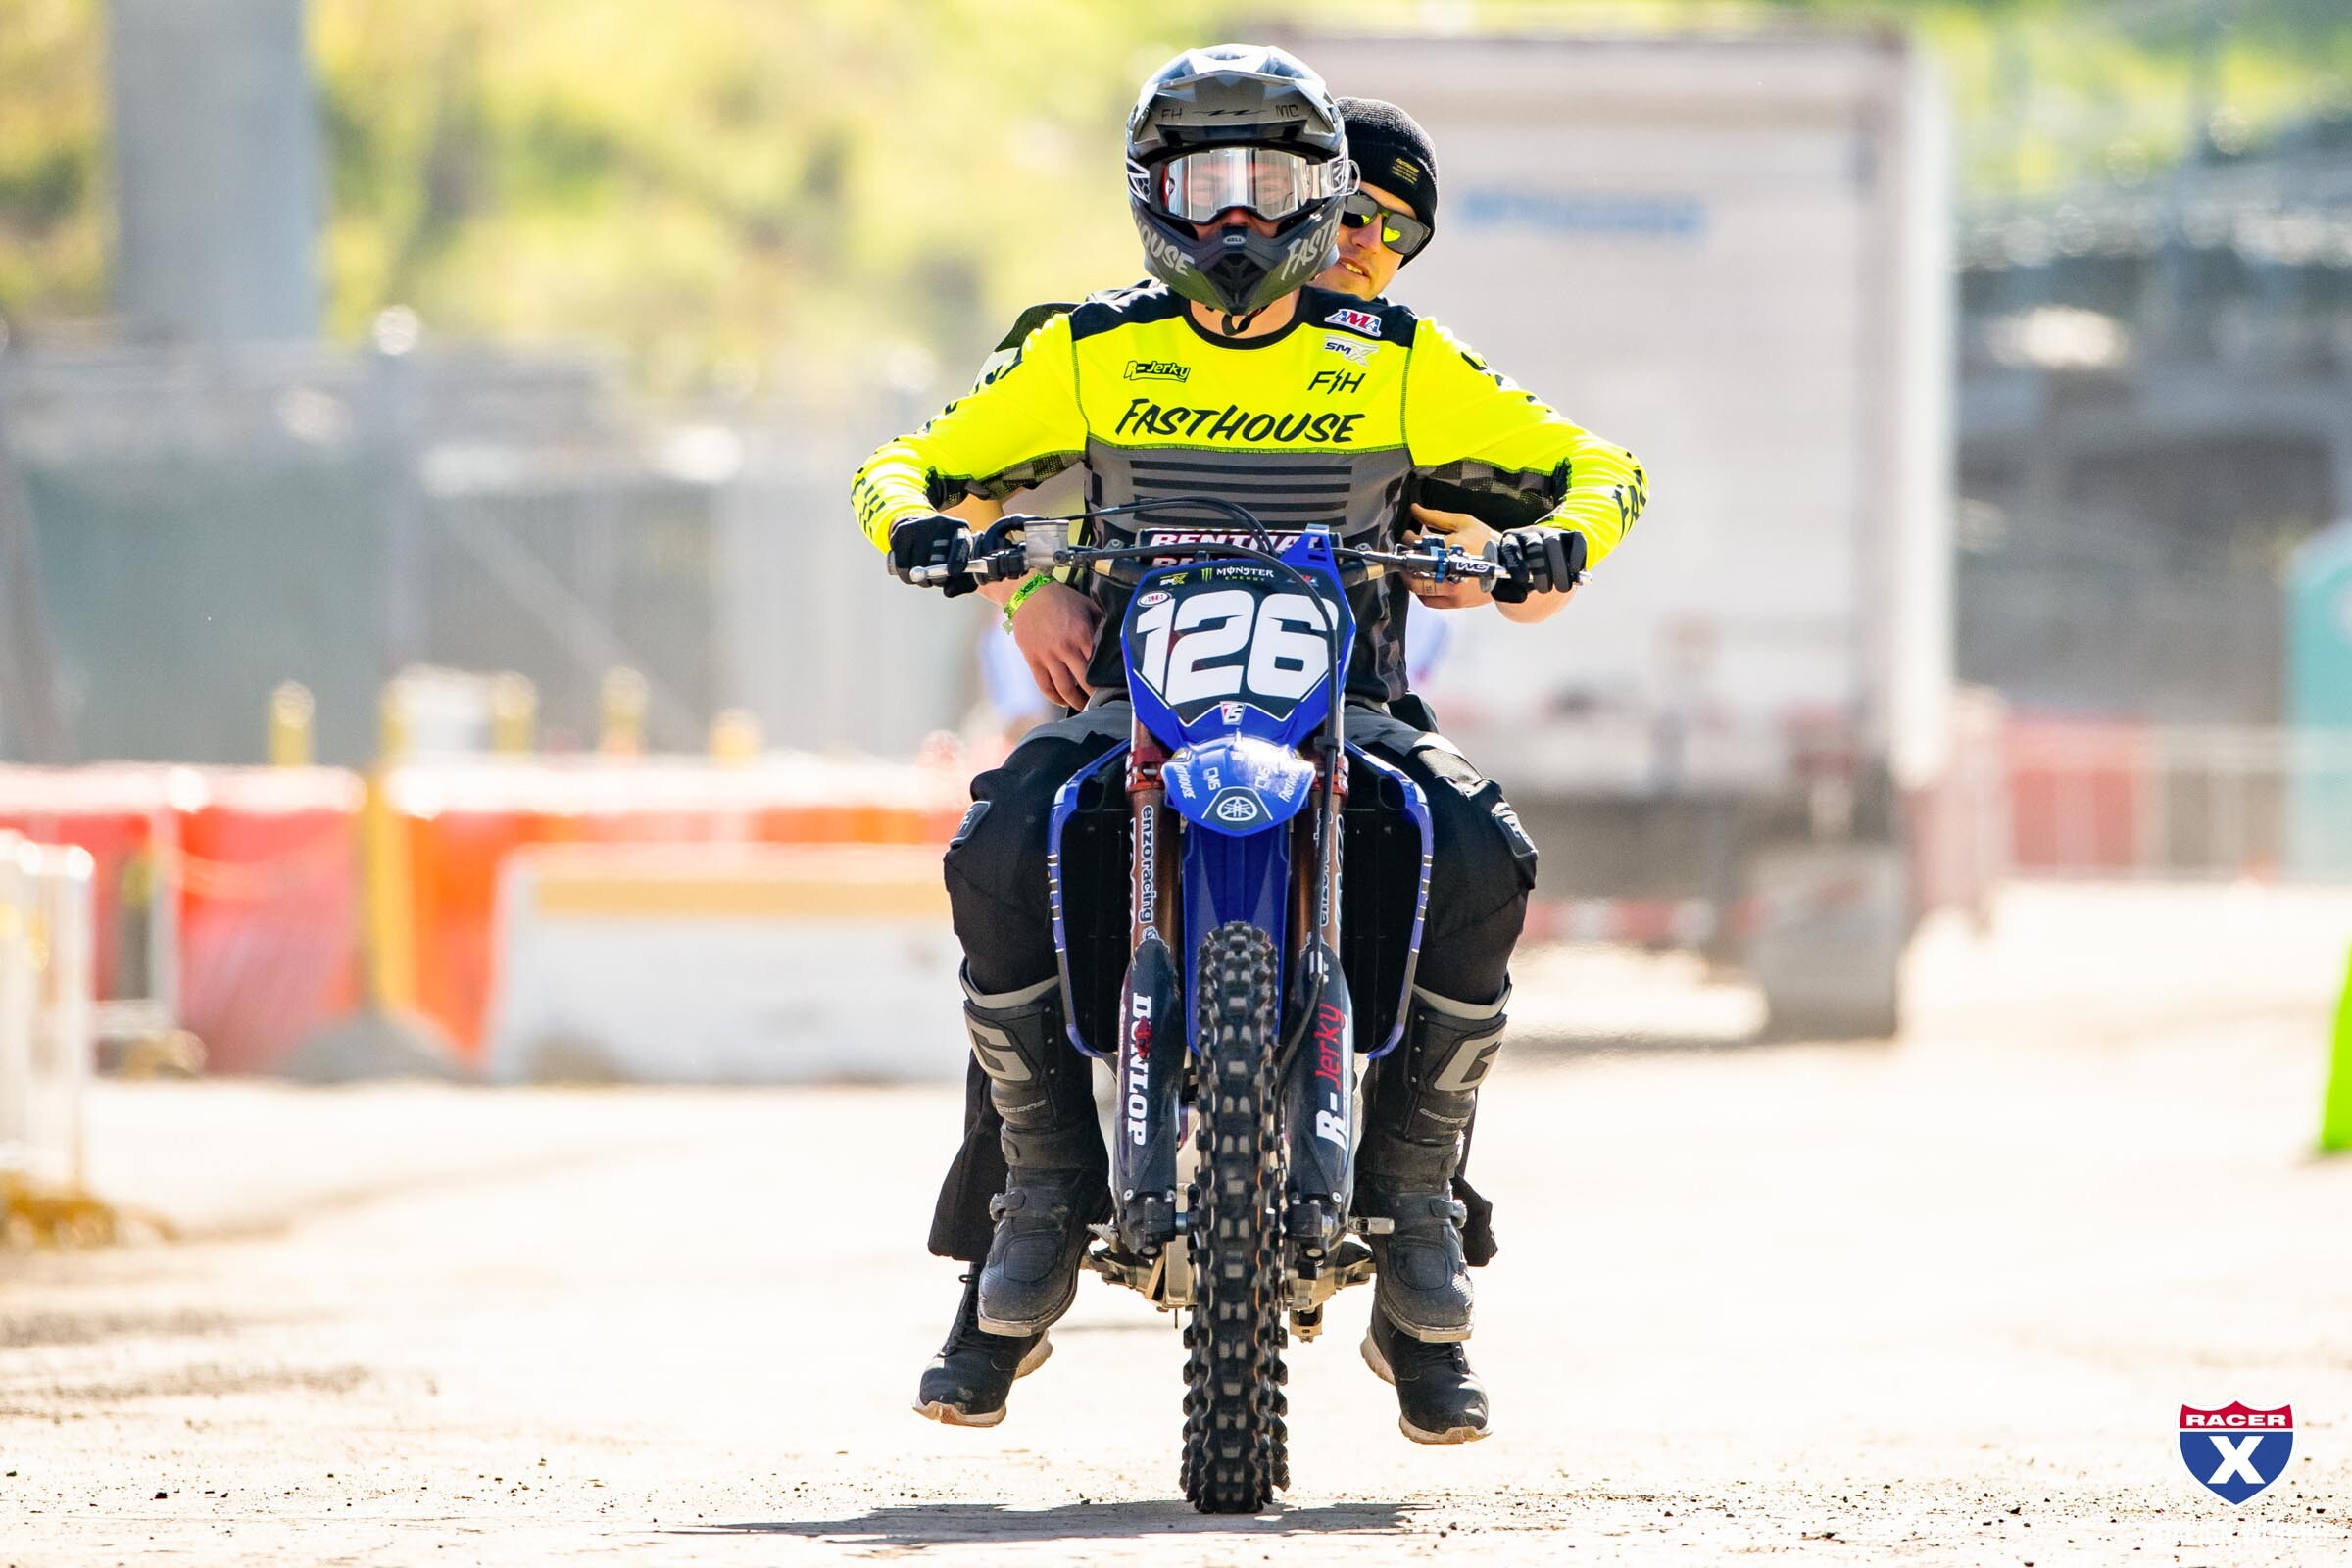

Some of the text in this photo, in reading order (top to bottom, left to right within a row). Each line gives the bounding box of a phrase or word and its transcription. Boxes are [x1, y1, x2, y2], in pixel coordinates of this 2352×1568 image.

[1135, 218, 1196, 277] OUSE
[1329, 310, 1381, 334] AMA
[1114, 397, 1366, 444] FASTHOUSE
[1216, 565, 1274, 578] MONSTER
[1136, 589, 1340, 707] 126
[1139, 805, 1157, 923] enzoracing
